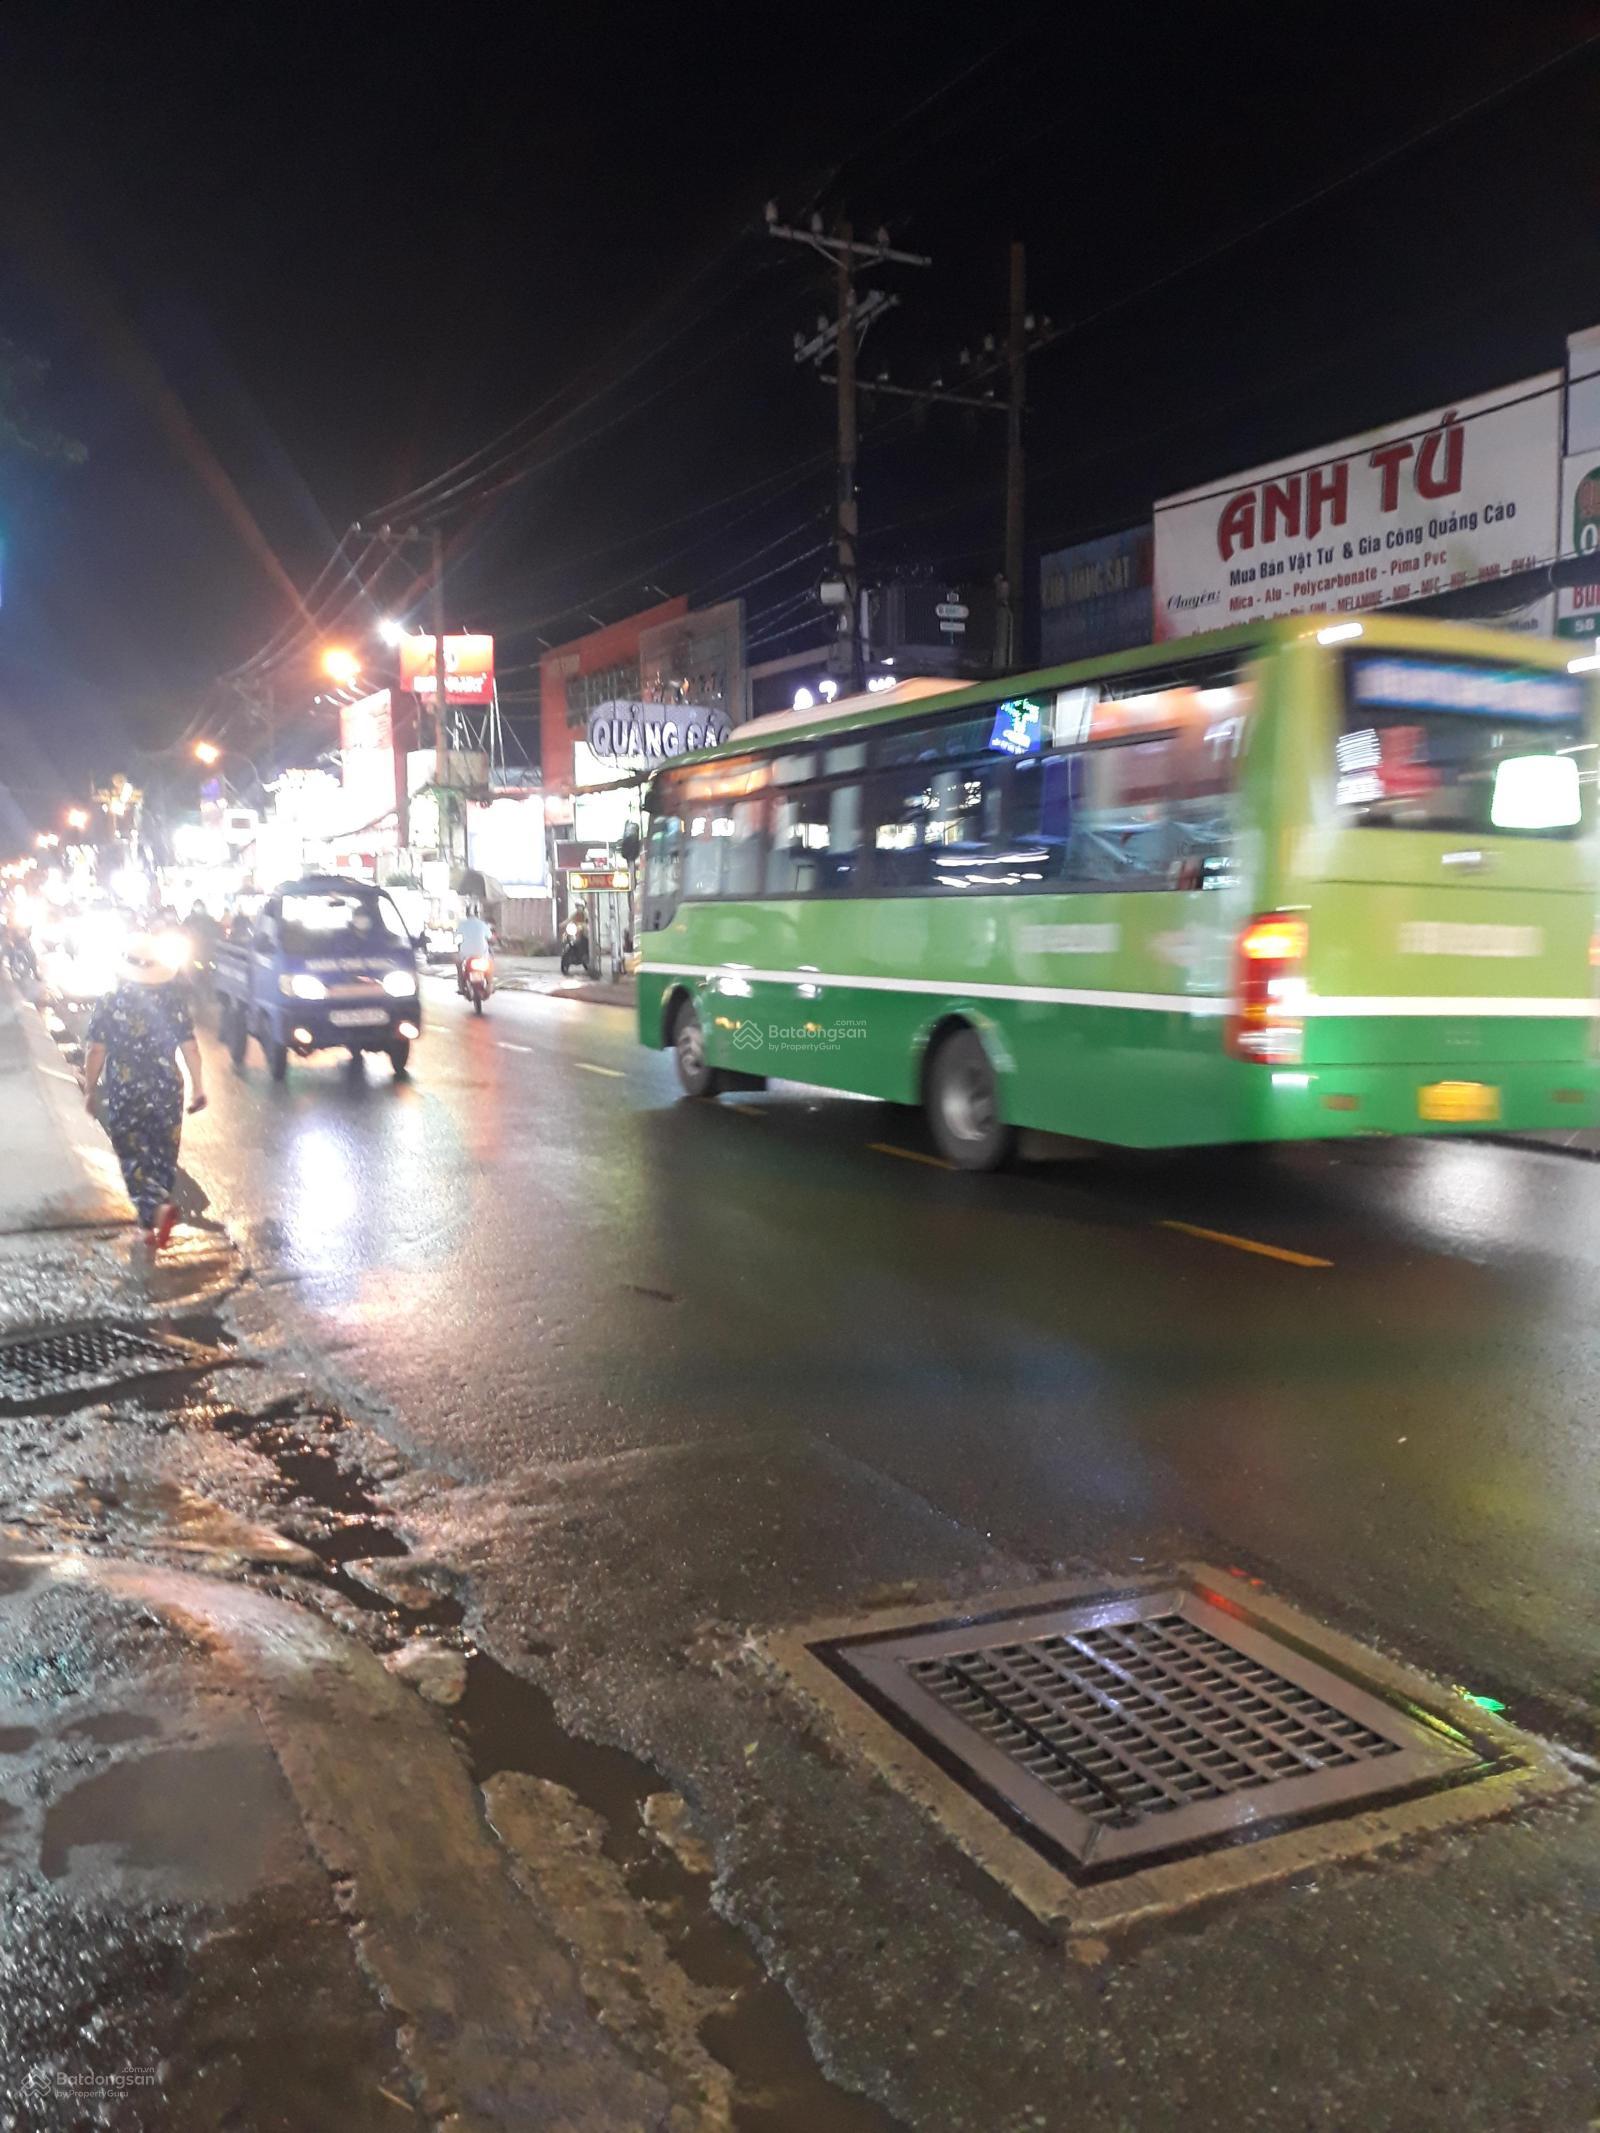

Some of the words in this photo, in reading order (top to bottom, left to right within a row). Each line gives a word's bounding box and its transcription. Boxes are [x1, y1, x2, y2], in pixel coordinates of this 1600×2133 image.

[1217, 462, 1349, 561] ANH
[1229, 596, 1254, 611] Mica
[1264, 589, 1282, 603] Alu
[1293, 568, 1377, 597] Polycarbonate
[1391, 557, 1420, 576] Pima
[1424, 551, 1447, 566] Pvc
[1230, 569, 1256, 587] Mua
[1260, 559, 1284, 579] Bán
[1289, 552, 1312, 574] Vật
[1342, 543, 1354, 560] &
[1359, 537, 1381, 556] Gia
[1386, 526, 1423, 549] Công
[592, 703, 679, 757] QUẢNG
